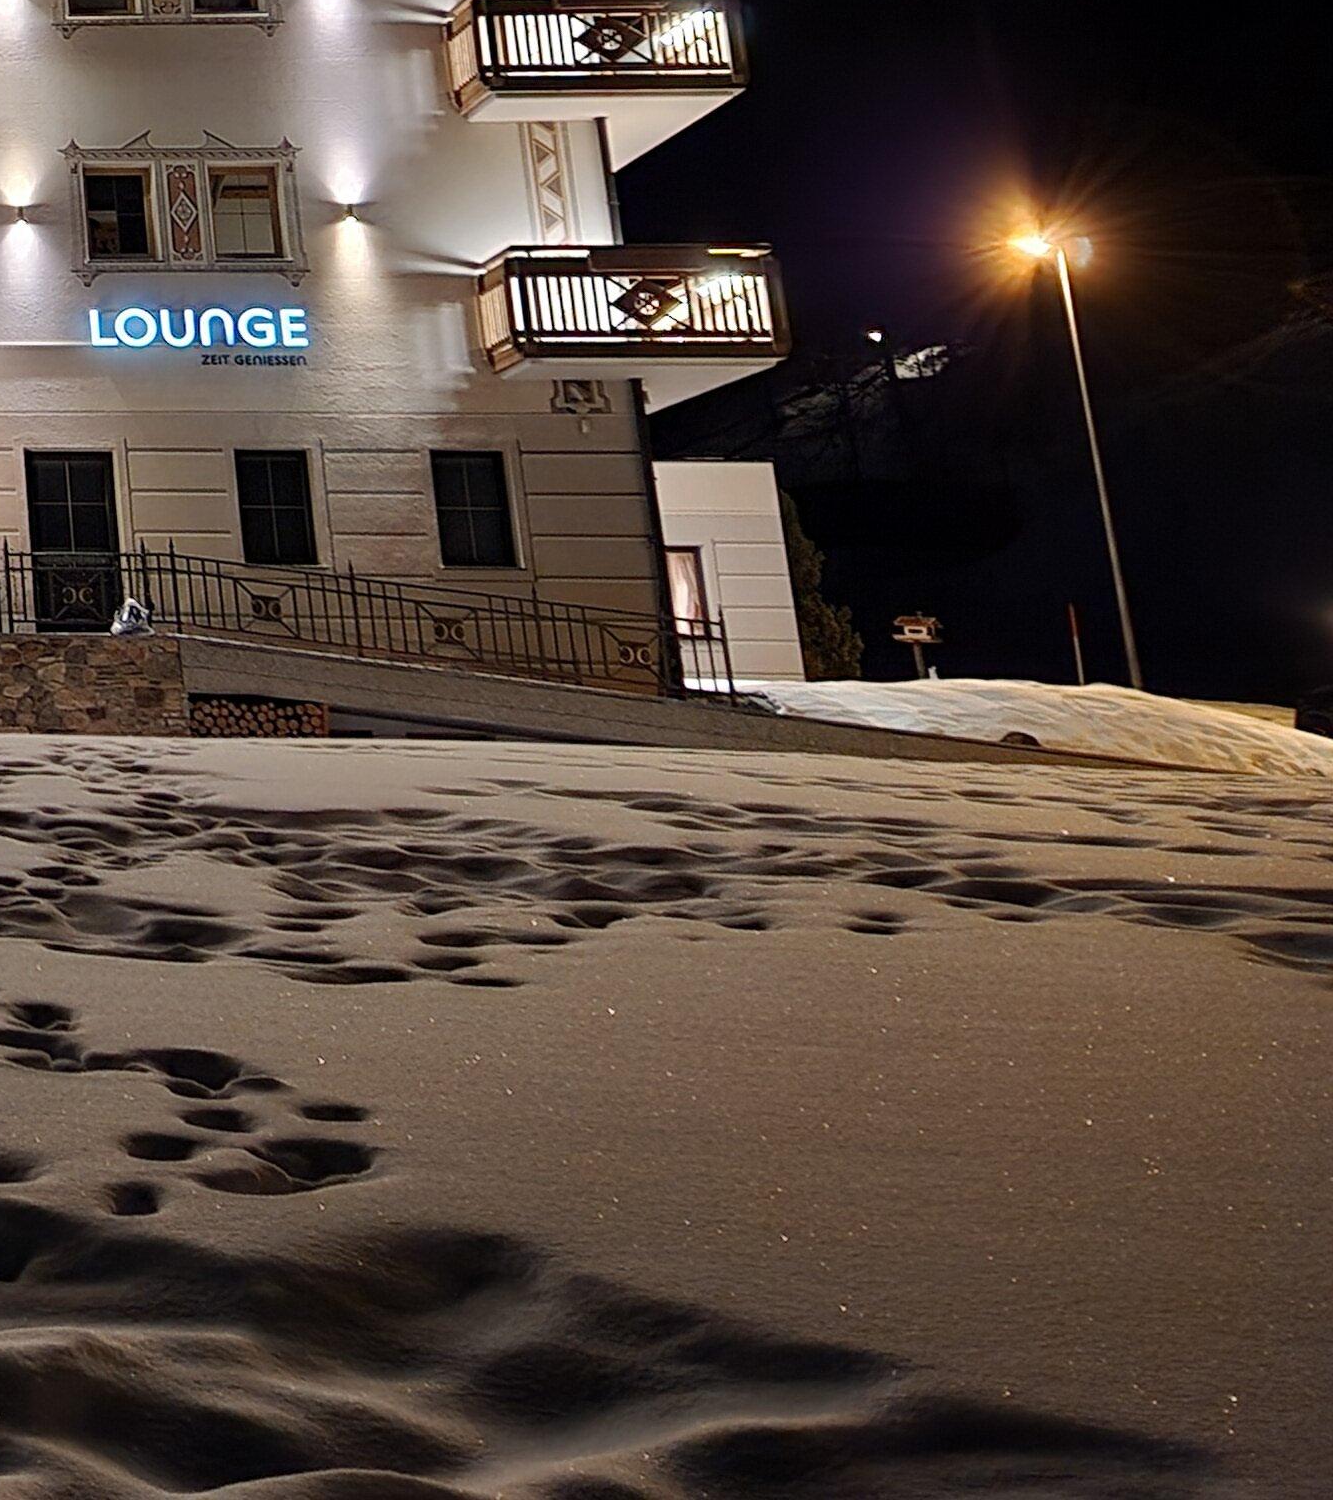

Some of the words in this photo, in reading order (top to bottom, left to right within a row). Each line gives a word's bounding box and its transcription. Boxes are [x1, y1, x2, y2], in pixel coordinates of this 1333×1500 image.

[88, 306, 310, 348] LOUNGE
[201, 354, 230, 367] ZEIT
[234, 353, 307, 367] GENIESSEN
